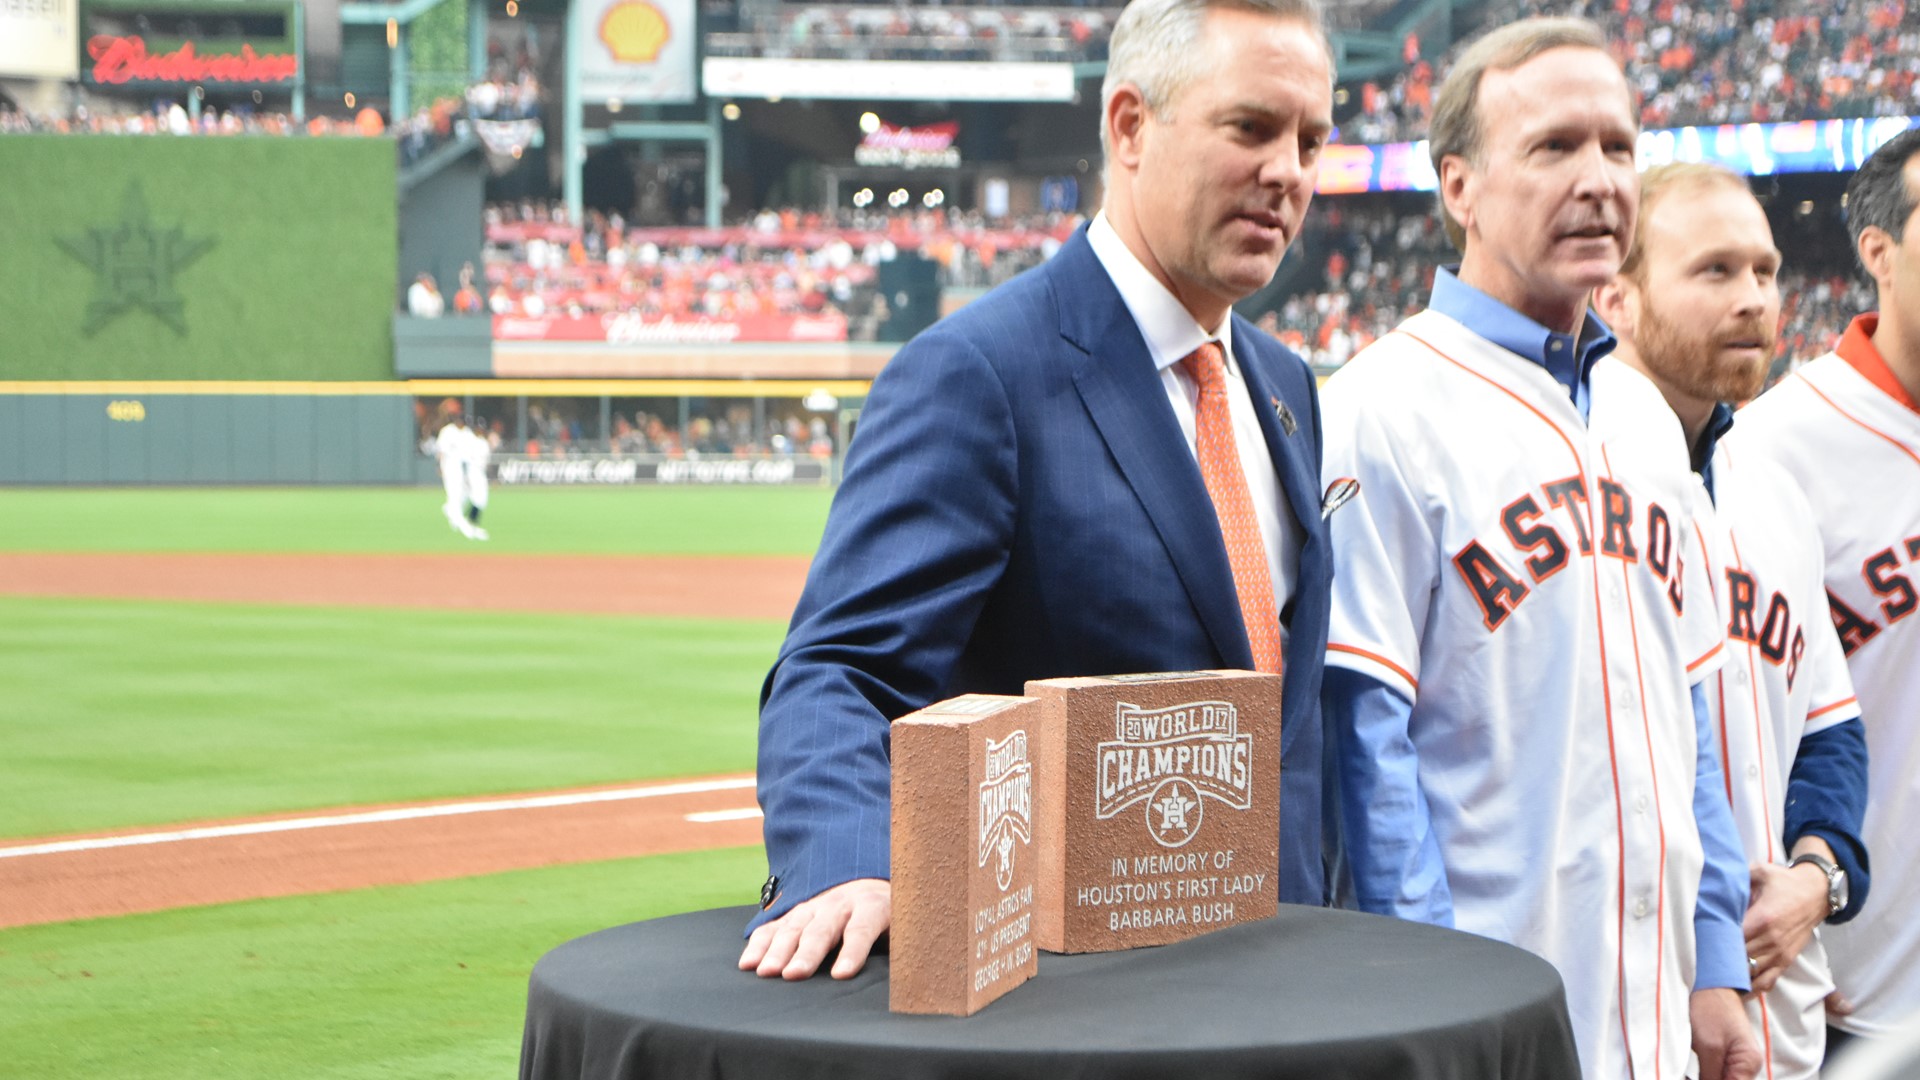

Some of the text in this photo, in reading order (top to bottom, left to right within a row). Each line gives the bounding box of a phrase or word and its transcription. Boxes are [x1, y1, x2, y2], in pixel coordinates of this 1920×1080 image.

[1824, 535, 1920, 660] AS
[1127, 706, 1228, 741] 20 WORLD 17
[995, 736, 1020, 778] WORLD
[1102, 742, 1247, 800] CHAMPIONS
[982, 772, 1030, 845] CHAMPIONS
[1112, 850, 1234, 877] IN MEMORY OF
[975, 883, 1033, 934] LOYAL ASTROS FAN
[1077, 873, 1266, 907] HOUSTON'S FIRST LADY
[991, 931, 999, 954] US
[1000, 911, 1031, 948] PRESIDENT
[1110, 902, 1234, 932] BARBARA BUSH
[975, 959, 1000, 992] GEORGE
[1016, 940, 1032, 968] BUSH
